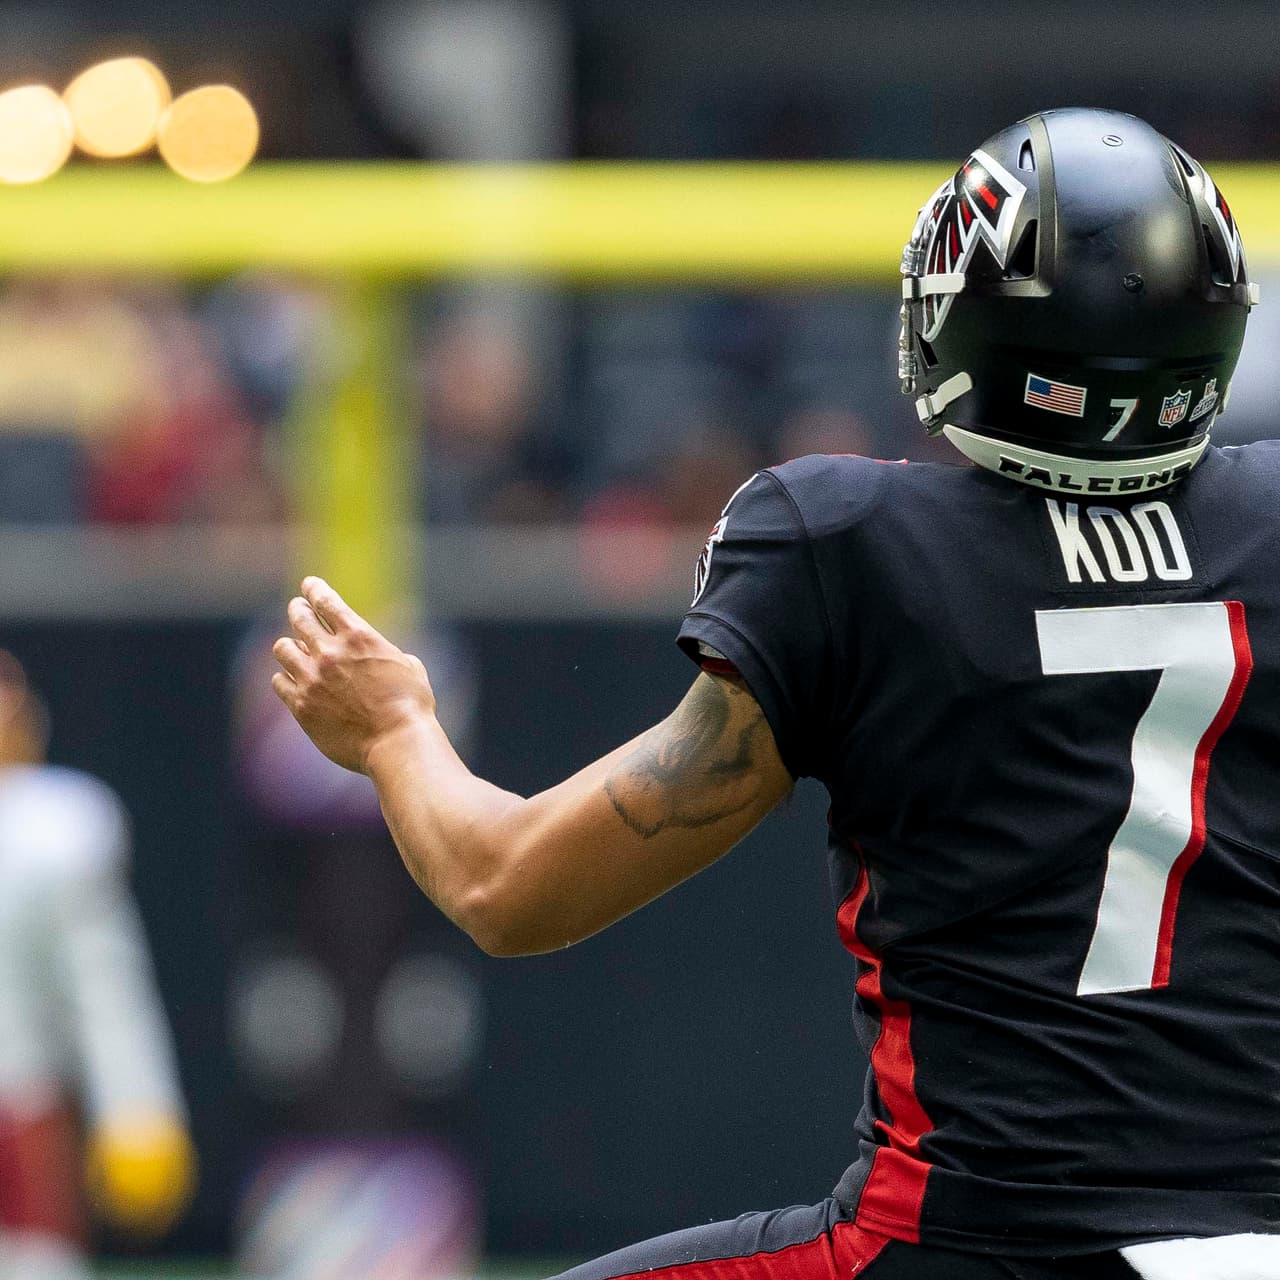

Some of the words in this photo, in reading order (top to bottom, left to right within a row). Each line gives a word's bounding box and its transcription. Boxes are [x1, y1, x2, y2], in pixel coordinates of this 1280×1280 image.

[1101, 397, 1139, 442] 7
[1045, 497, 1193, 583] KOO
[1034, 600, 1254, 997] 7
